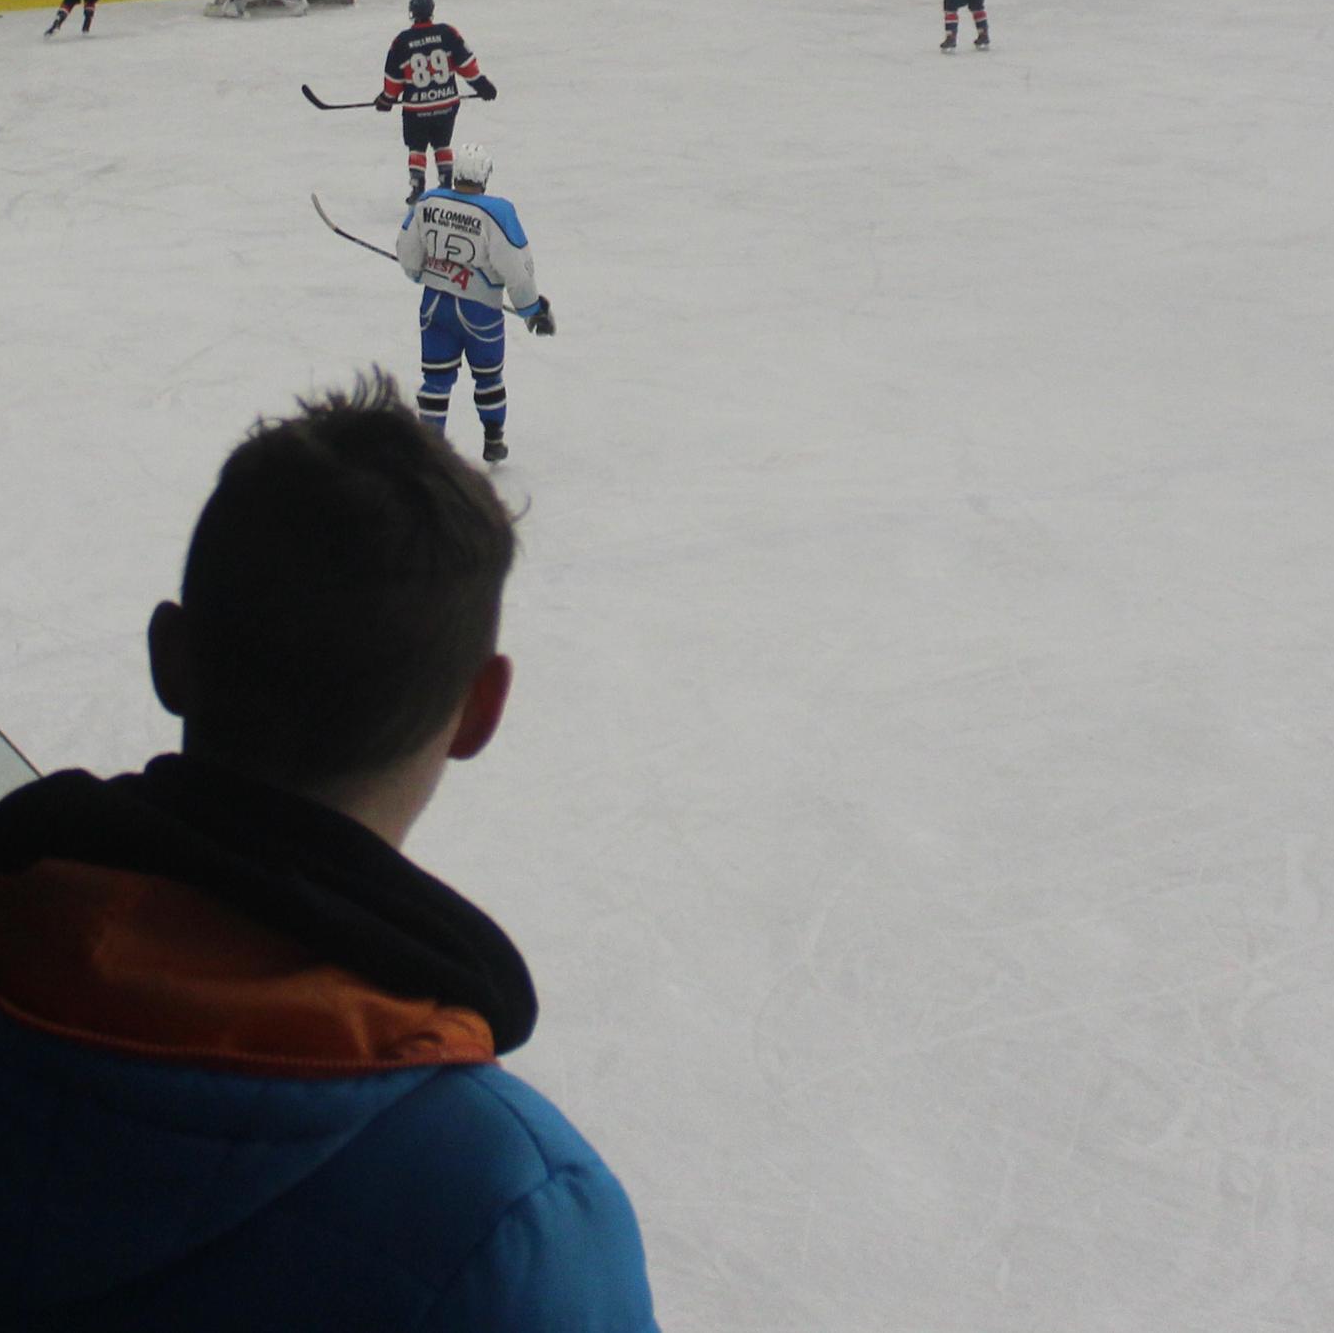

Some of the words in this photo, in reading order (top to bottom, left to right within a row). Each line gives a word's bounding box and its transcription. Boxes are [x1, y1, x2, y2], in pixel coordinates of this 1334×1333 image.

[411, 49, 451, 88] 89
[420, 85, 456, 102] RONAL
[423, 207, 440, 224] HC
[440, 209, 482, 229] LOMNICE
